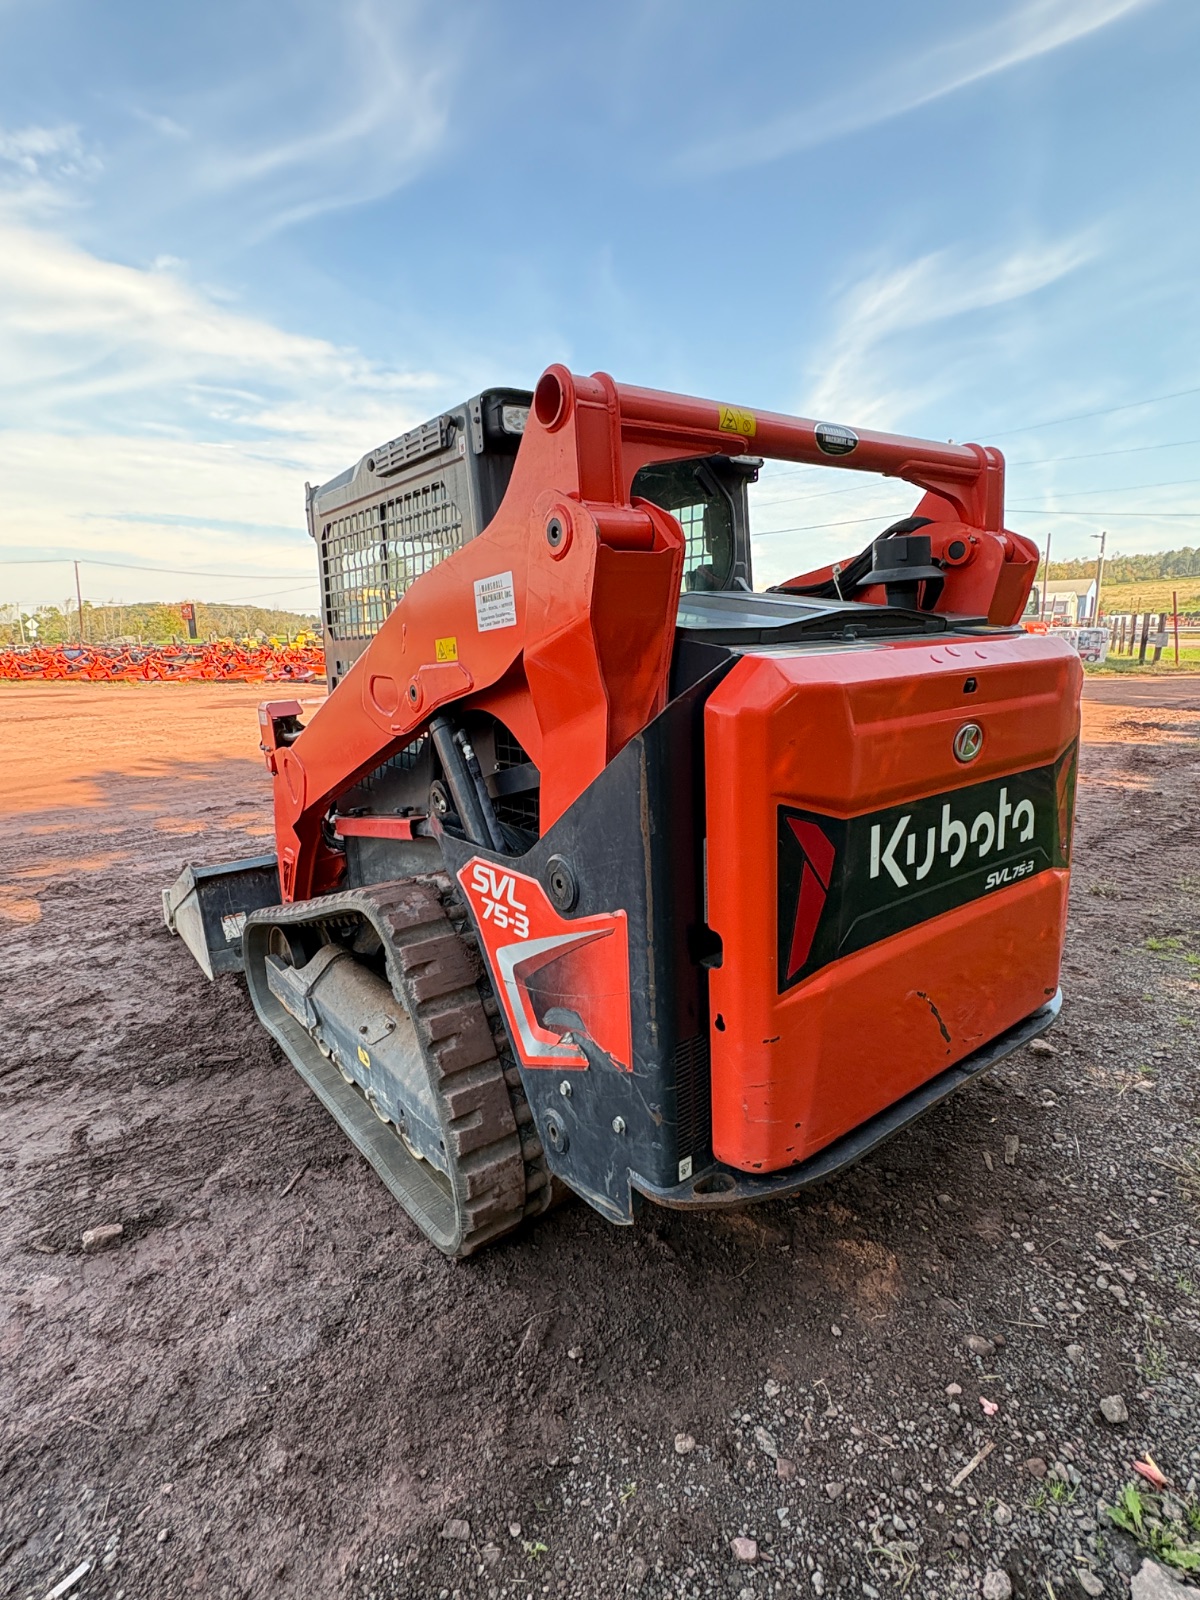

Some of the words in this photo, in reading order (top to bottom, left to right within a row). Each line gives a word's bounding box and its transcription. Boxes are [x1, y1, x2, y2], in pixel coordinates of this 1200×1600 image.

[481, 579, 503, 593] MARSHALL
[869, 787, 1035, 888] Kubota
[471, 864, 527, 912] SVL
[985, 860, 1035, 890] SVL75-3
[481, 896, 530, 939] 75-3
